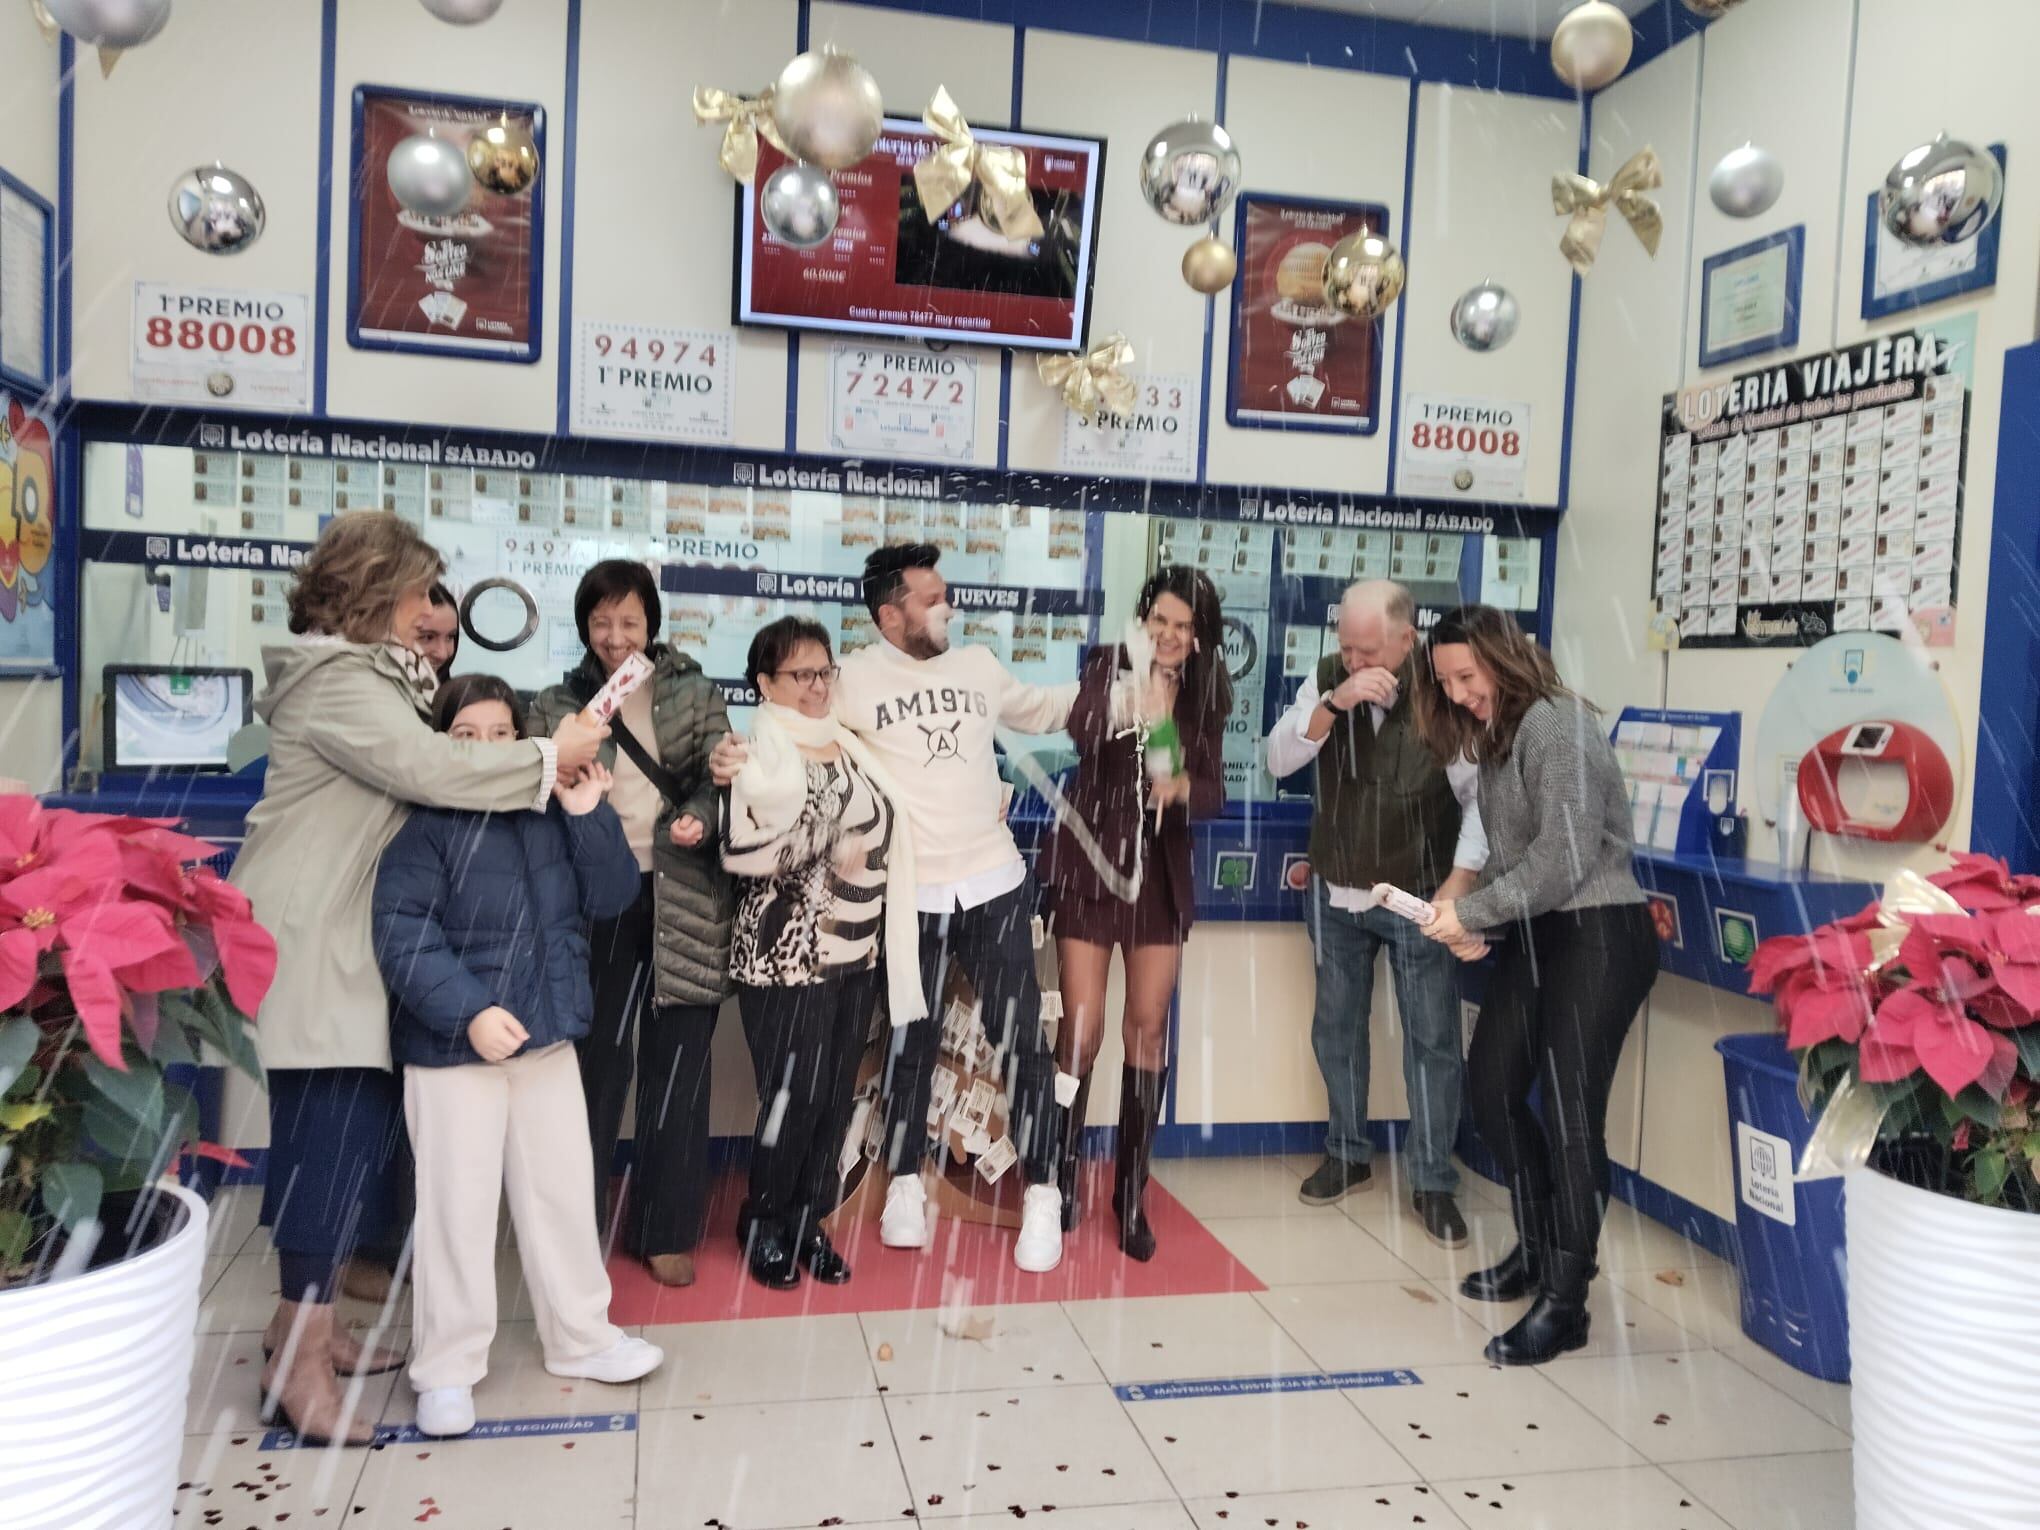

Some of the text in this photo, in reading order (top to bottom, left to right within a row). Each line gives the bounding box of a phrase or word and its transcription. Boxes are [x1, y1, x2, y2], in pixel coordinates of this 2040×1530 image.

[179, 295, 284, 321] PREMIO
[146, 316, 297, 357] 88008
[594, 334, 717, 368] 94974
[883, 353, 956, 376] PREMIO
[619, 367, 713, 394] PREMIO
[846, 371, 964, 404] 72472
[1683, 331, 1938, 425] LOTERIA VIAJERA
[1437, 404, 1513, 426] PREMIO
[230, 426, 536, 469] Lotería Nacional SÁBADO
[1411, 421, 1521, 457] 88008
[760, 464, 941, 498] Lotería Nacional
[1262, 500, 1494, 533] Lotería Nacional SÁBADO
[176, 538, 264, 564] Lotería
[667, 536, 759, 560] PREMIO
[781, 575, 855, 598] Lotería
[952, 587, 1020, 608] JUEVES
[875, 687, 988, 731] AM1976
[1749, 1188, 1785, 1215] Nacional
[492, 1424, 512, 1434] DE
[514, 1419, 595, 1433] SEGURIDAD
